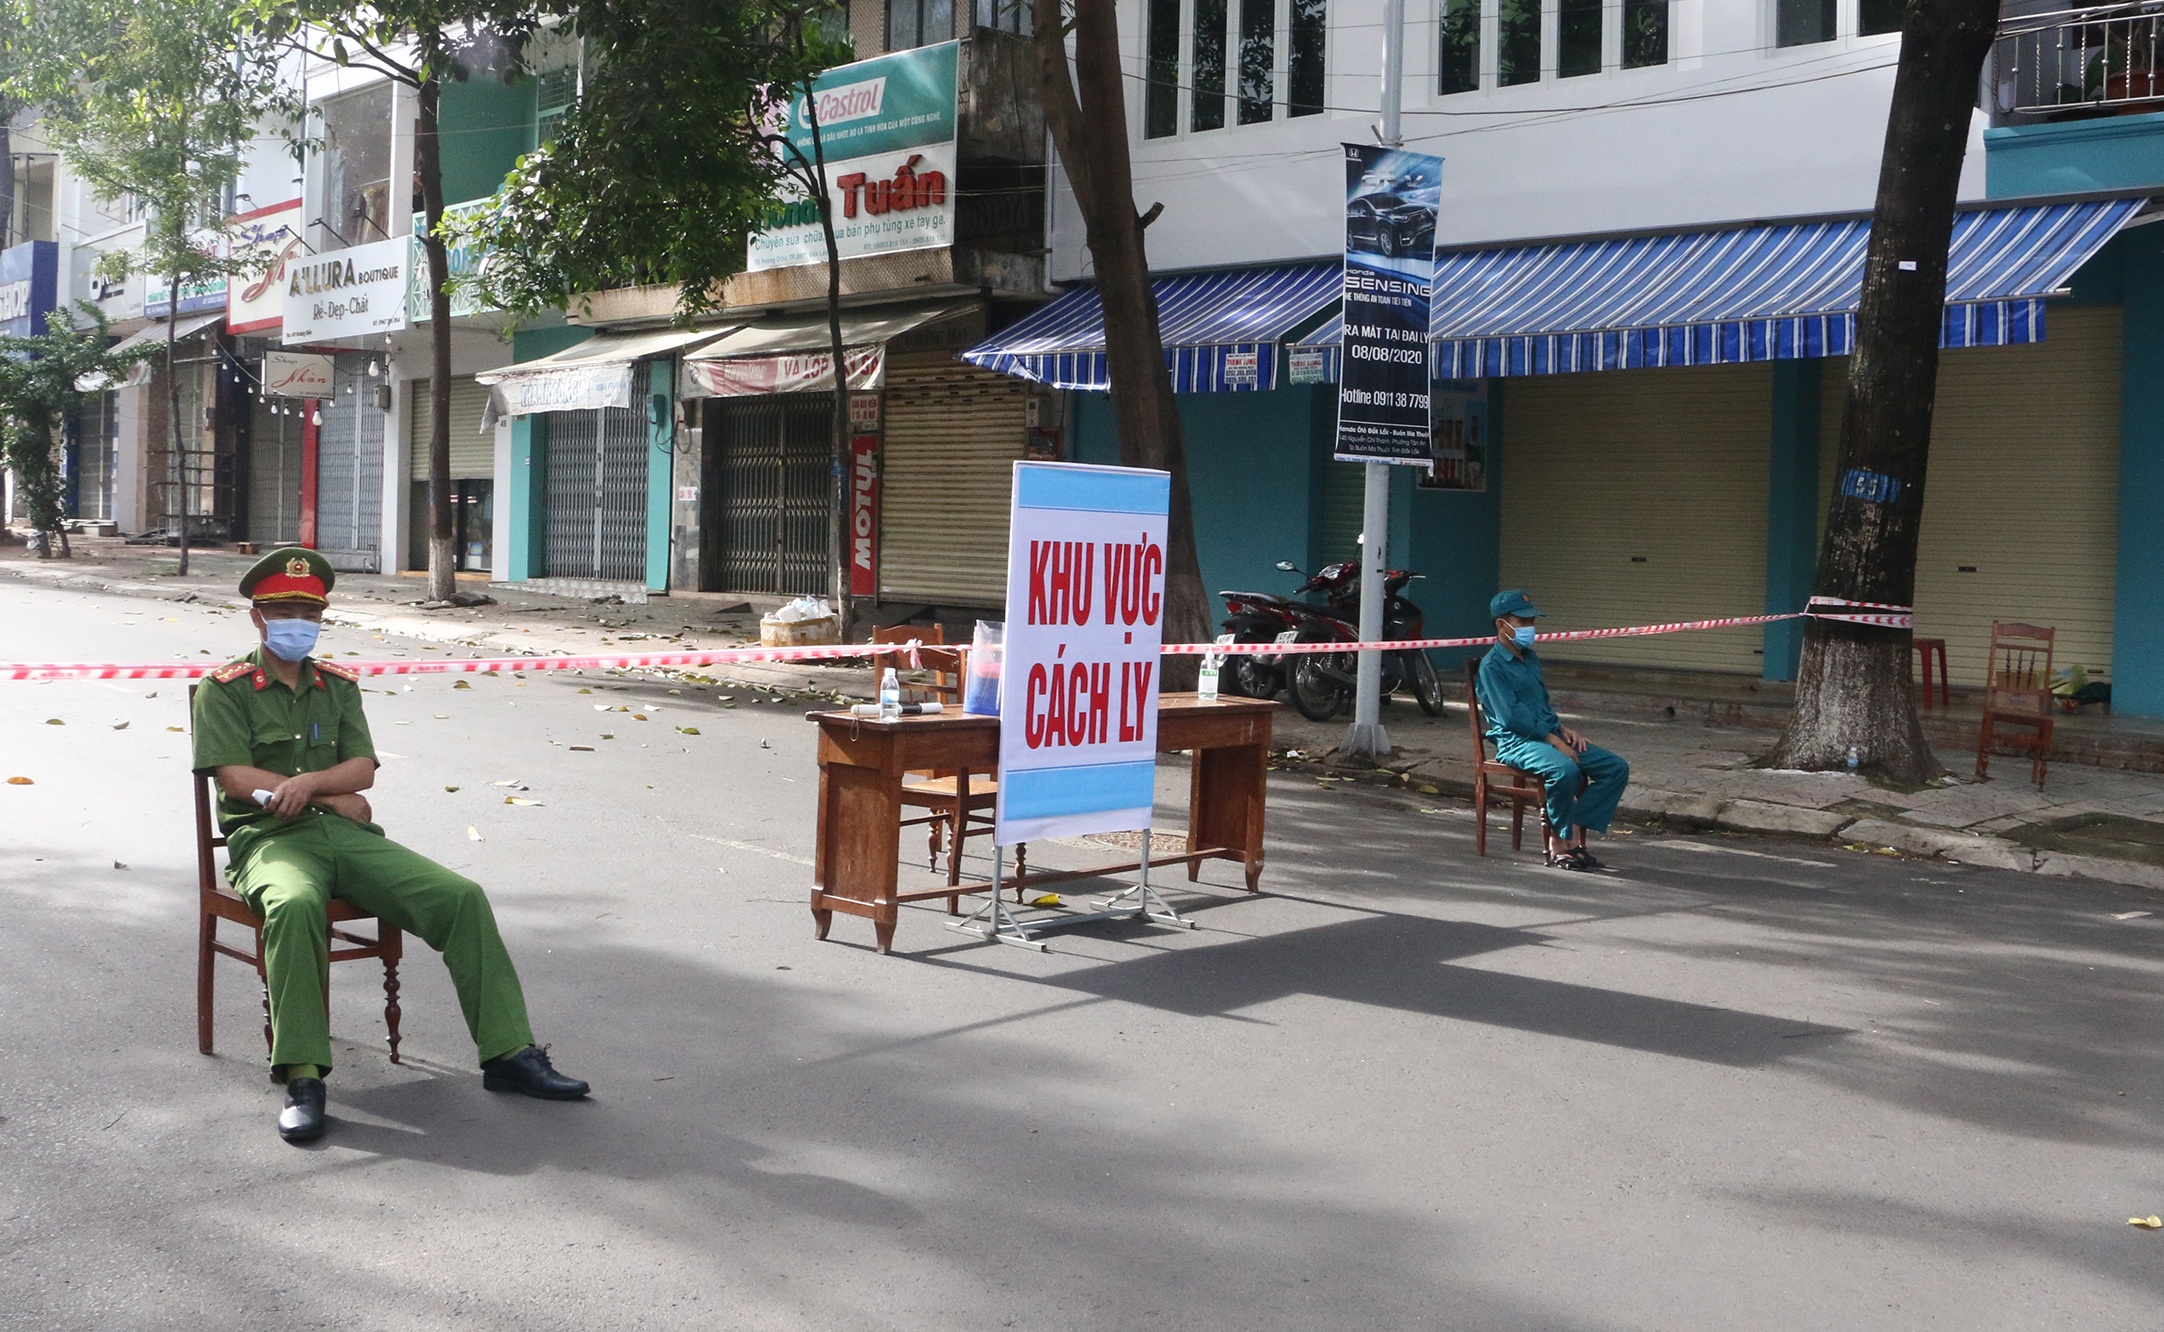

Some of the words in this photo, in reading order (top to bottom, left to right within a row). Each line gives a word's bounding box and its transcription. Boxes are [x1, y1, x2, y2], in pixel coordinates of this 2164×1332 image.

[818, 83, 879, 122] Castrol
[837, 154, 946, 219] Tuấn
[834, 228, 845, 240] ua
[846, 223, 862, 238] bán
[882, 218, 902, 234] tùng
[904, 219, 915, 229] xe
[917, 215, 930, 230] tay
[358, 265, 399, 285] BOUTIQUE
[1345, 275, 1431, 297] SENSING
[1343, 323, 1359, 336] RA
[1401, 330, 1419, 343] ĐẠI
[1351, 344, 1422, 365] 08/08/2020
[1373, 390, 1394, 406] 0911
[1395, 392, 1407, 407] 38
[1408, 393, 1429, 409] 7799
[855, 449, 872, 571] MOTUL
[1027, 540, 1095, 627] KHU
[1025, 643, 1111, 750] CÁCH
